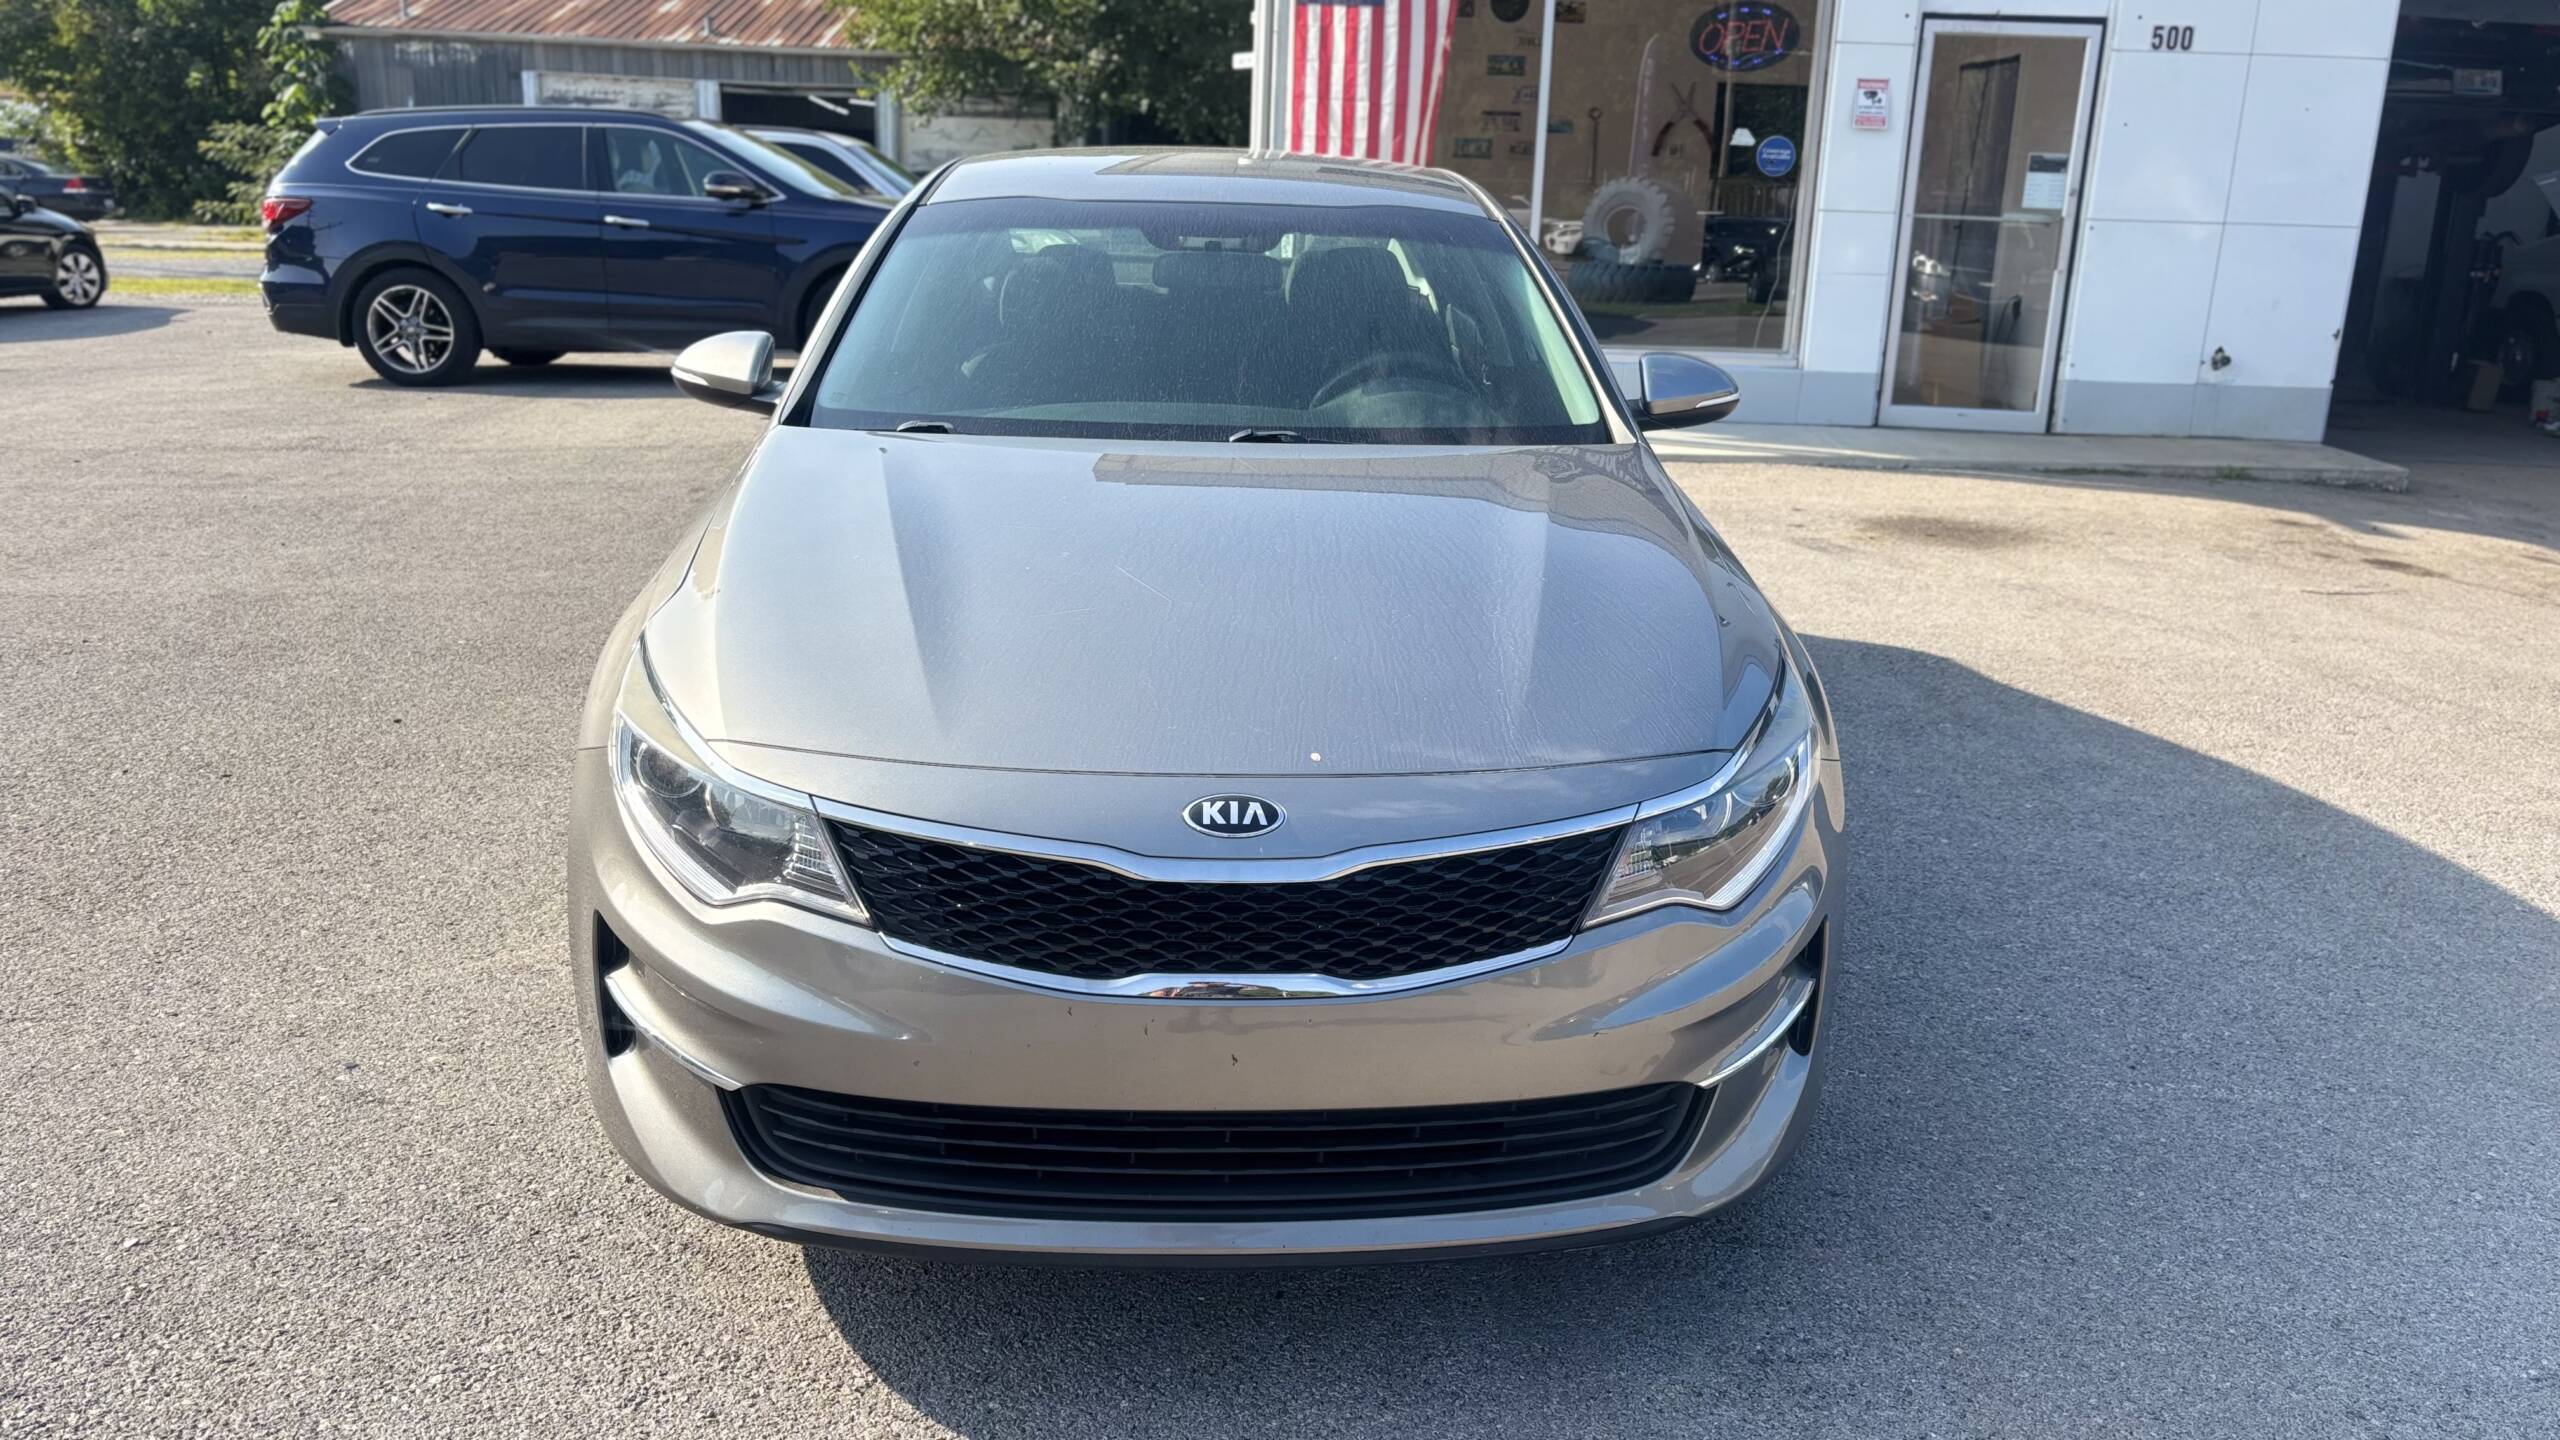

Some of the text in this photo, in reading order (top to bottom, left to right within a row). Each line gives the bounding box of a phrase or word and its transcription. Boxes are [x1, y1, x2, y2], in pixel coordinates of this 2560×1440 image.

[1699, 18, 1788, 54] OPEN
[2151, 25, 2194, 50] 500
[1202, 801, 1268, 825] KIA
